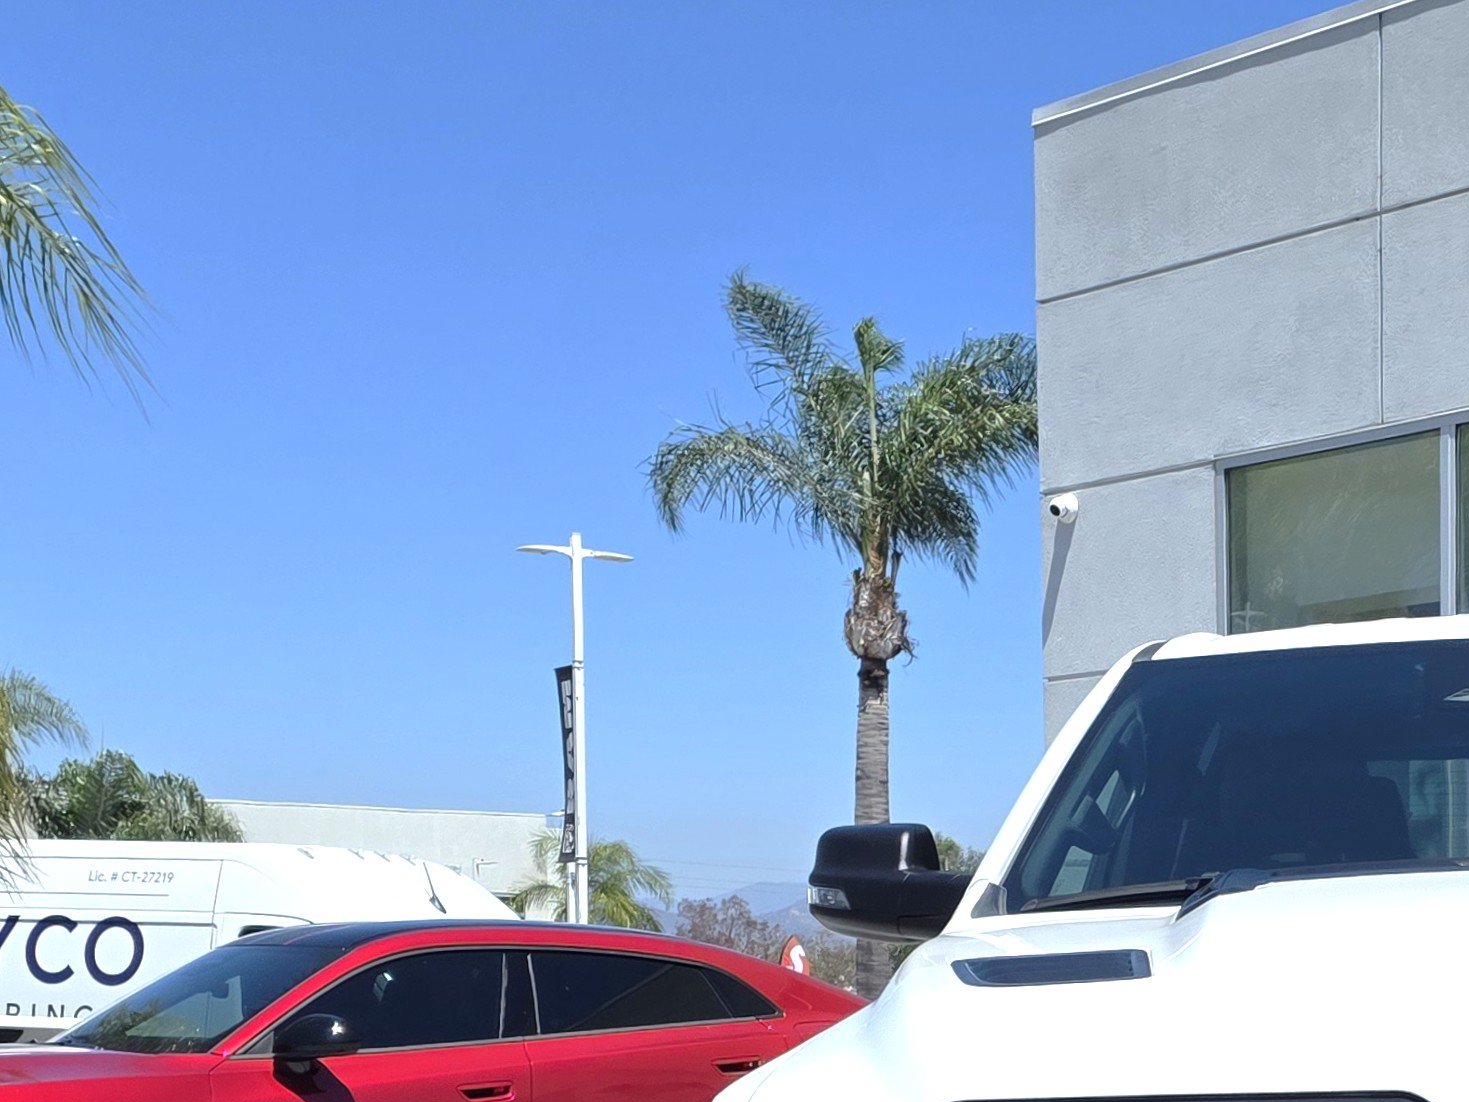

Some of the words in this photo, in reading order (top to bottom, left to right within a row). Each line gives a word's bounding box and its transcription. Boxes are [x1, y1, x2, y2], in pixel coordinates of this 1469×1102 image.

[88, 870, 107, 882] Lic.
[111, 871, 118, 882] #
[121, 871, 174, 884] CT-27219
